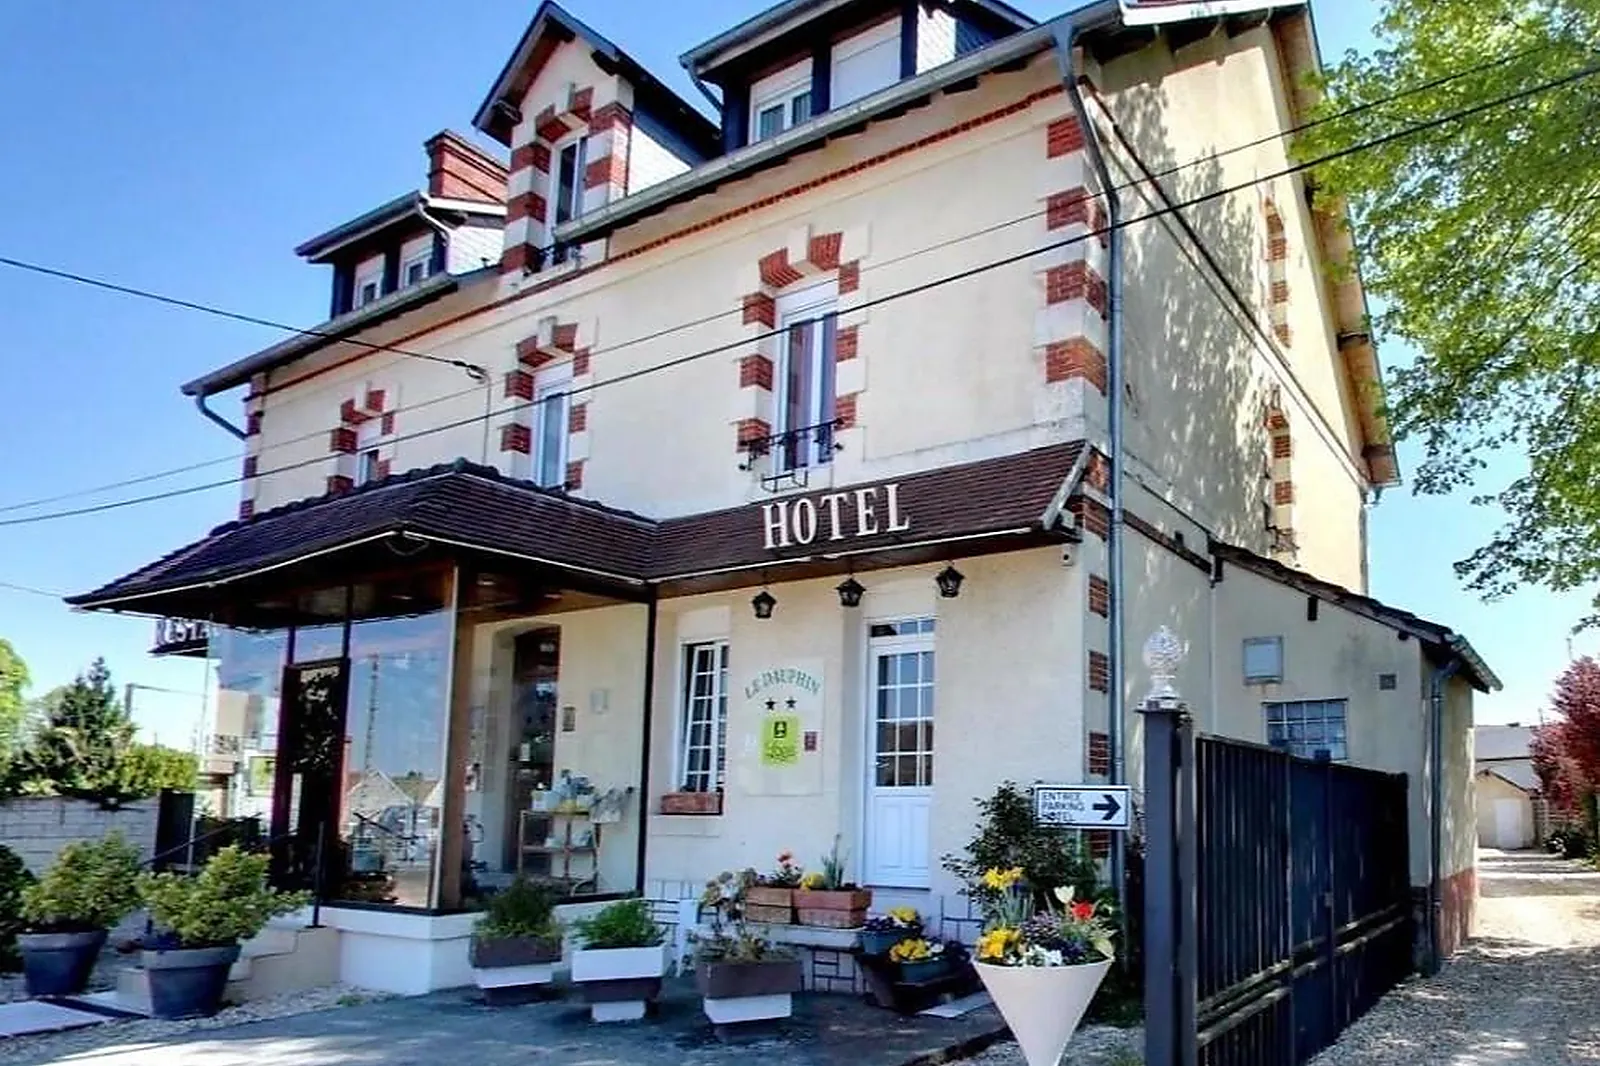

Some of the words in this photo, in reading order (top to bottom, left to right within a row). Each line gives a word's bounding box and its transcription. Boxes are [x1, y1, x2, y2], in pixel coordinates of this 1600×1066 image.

[762, 484, 909, 549] HOTEL
[762, 668, 821, 696] DAUPHIN
[1041, 801, 1085, 812] PARKING
